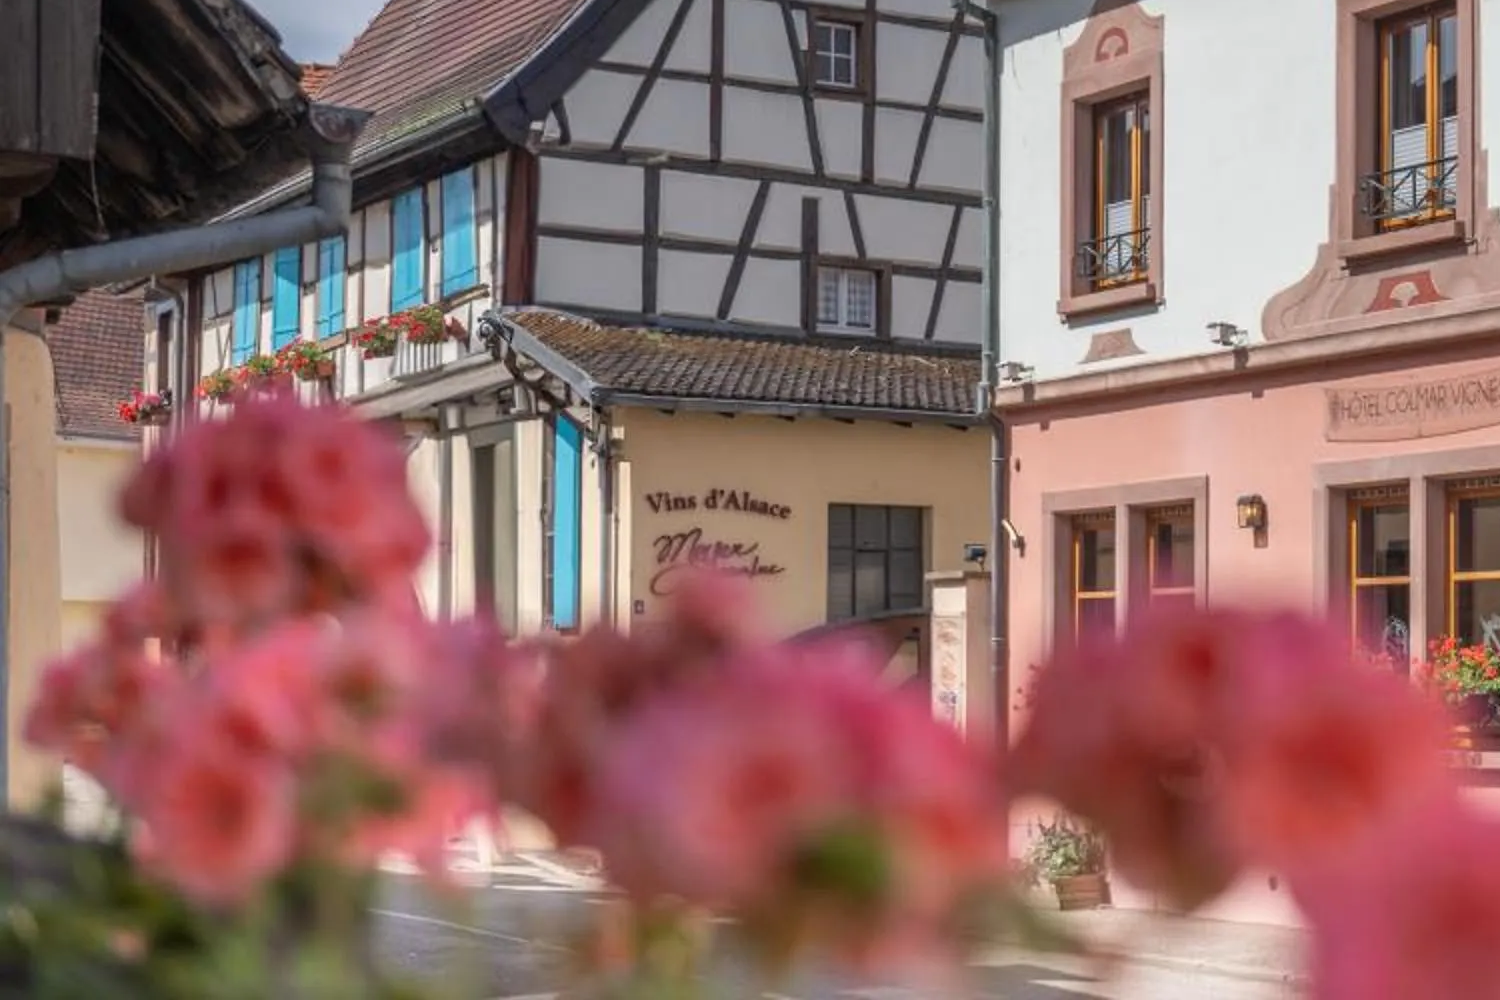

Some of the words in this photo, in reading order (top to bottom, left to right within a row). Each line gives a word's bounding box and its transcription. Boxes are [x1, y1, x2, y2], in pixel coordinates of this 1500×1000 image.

[1385, 383, 1447, 414] COLMAR
[645, 490, 698, 514] Vins
[703, 487, 792, 520] d'Alsace
